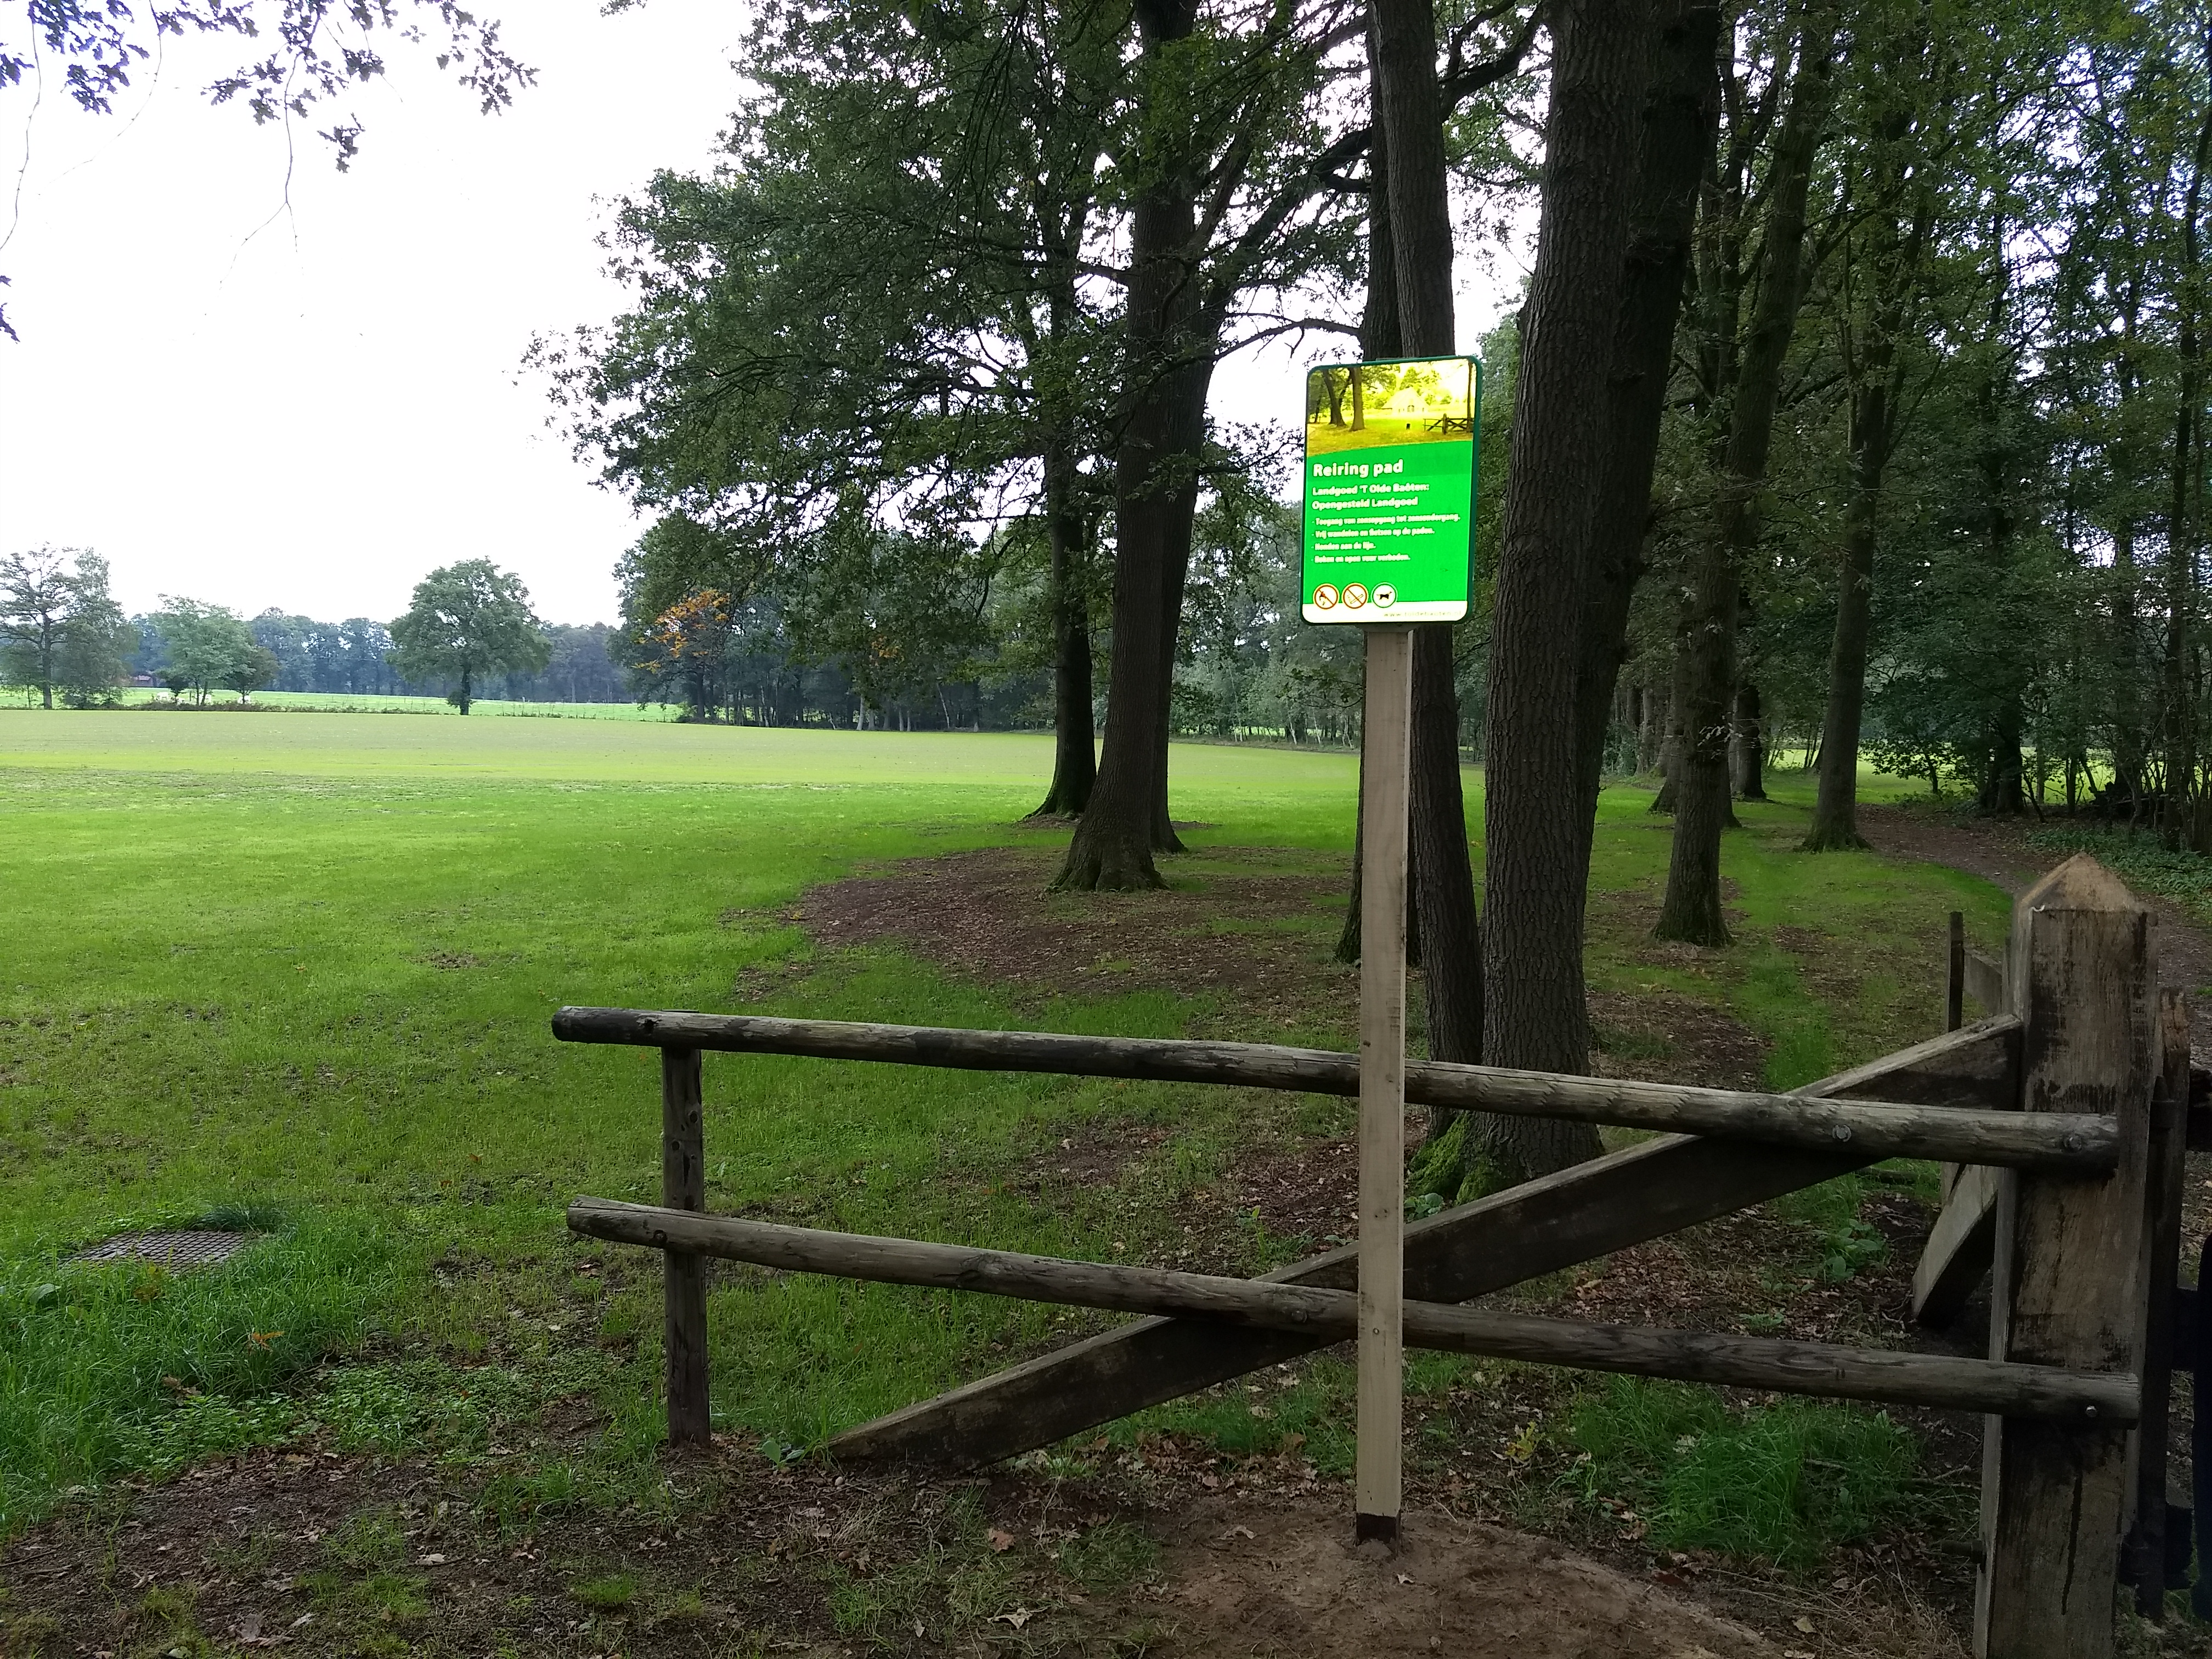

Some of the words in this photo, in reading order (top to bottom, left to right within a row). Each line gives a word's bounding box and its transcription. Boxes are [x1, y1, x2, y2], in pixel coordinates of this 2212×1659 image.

[1313, 462, 1369, 478] Reiring
[1373, 459, 1403, 477] pad
[1312, 485, 1358, 497] Landgoed
[1369, 483, 1392, 493] Olde
[1312, 498, 1370, 511] Opengesteld
[1372, 496, 1418, 509] Landgoed
[1315, 517, 1344, 527] Toegang
[1396, 515, 1407, 523] tot
[1315, 530, 1327, 539] Vrij
[1327, 529, 1359, 538] wandelen
[1392, 529, 1402, 537] op
[1402, 527, 1412, 535] de
[1314, 542, 1340, 551] Honden
[1353, 541, 1362, 550] de
